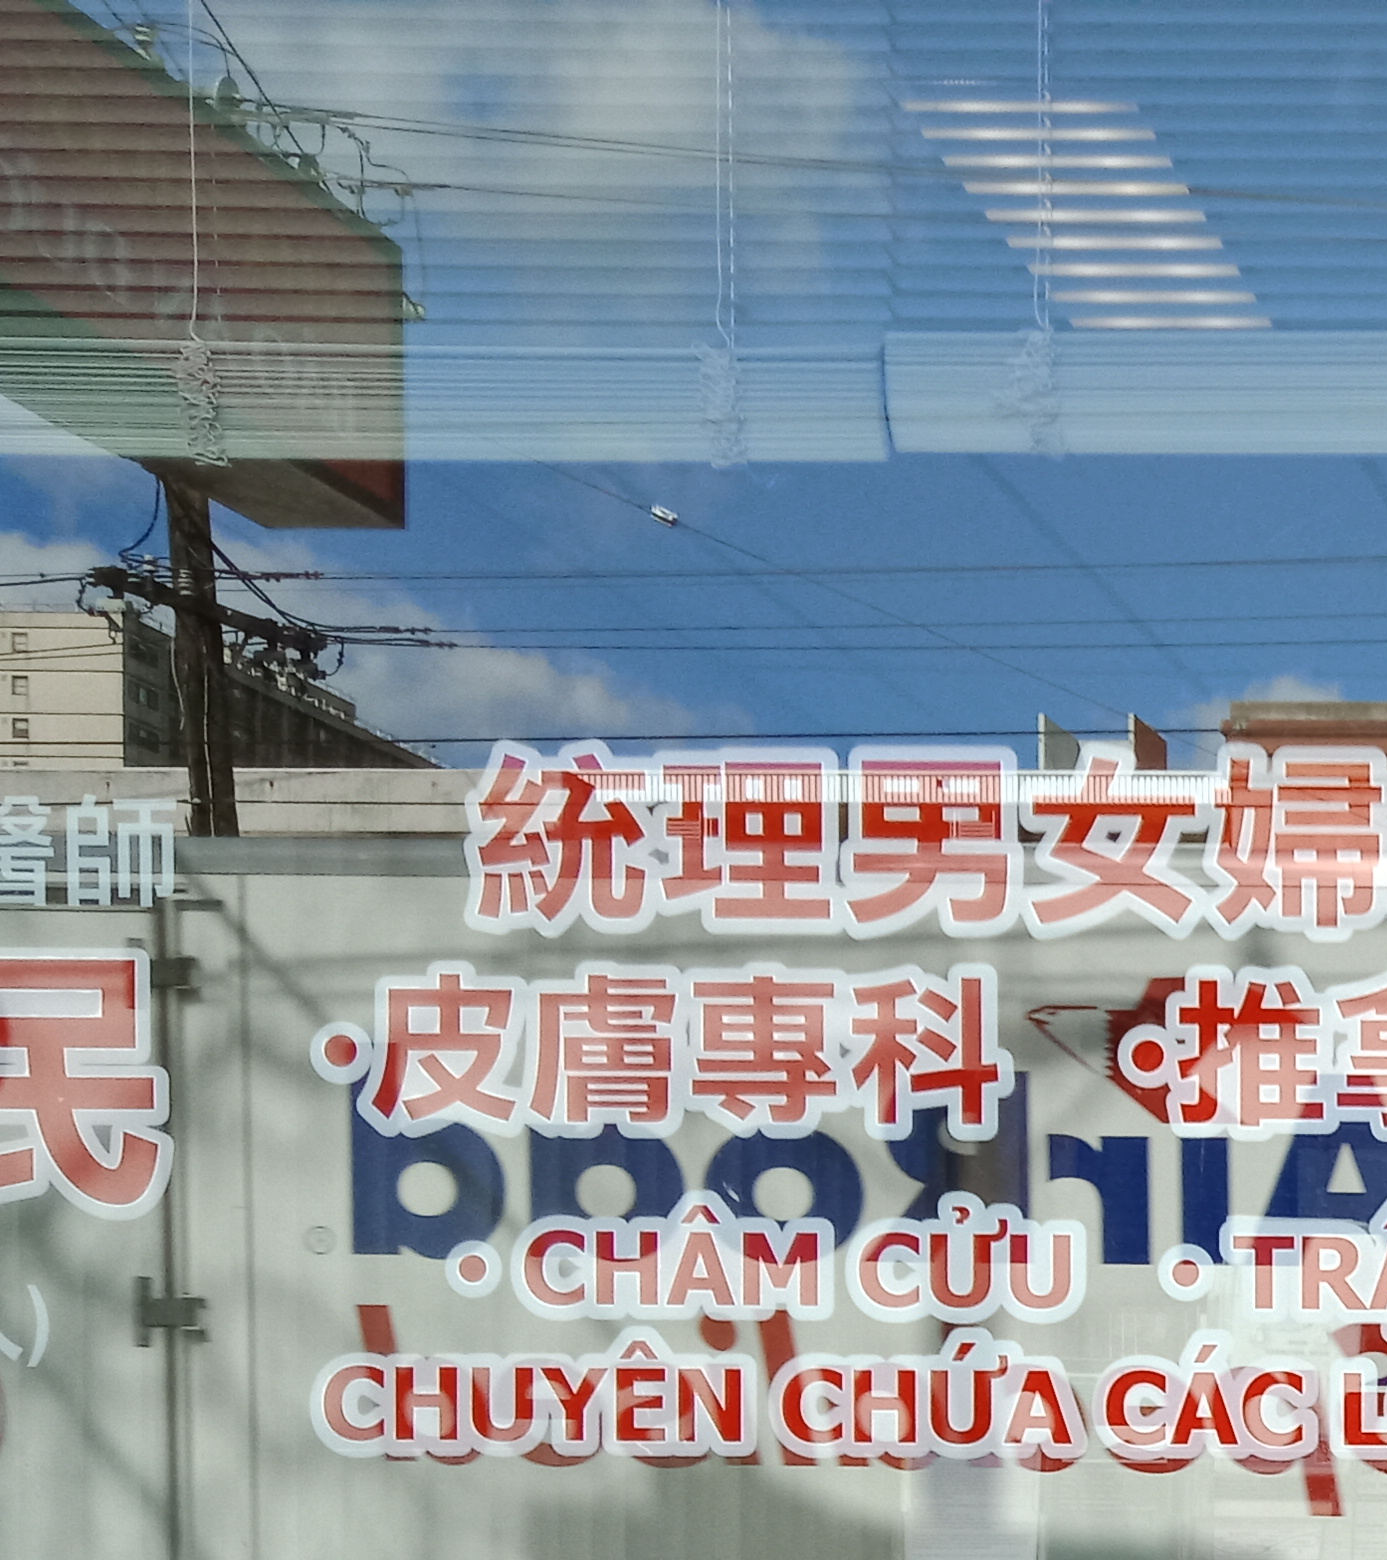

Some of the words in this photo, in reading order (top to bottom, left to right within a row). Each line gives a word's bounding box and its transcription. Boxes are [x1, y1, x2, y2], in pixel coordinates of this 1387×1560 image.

[369, 971, 1001, 1128] 皮膚專科
[523, 1204, 820, 1309] CHÂM
[859, 1204, 1073, 1309] CỬU
[321, 1339, 744, 1444] CHUYÊN
[1105, 1344, 1307, 1448] CÁC
